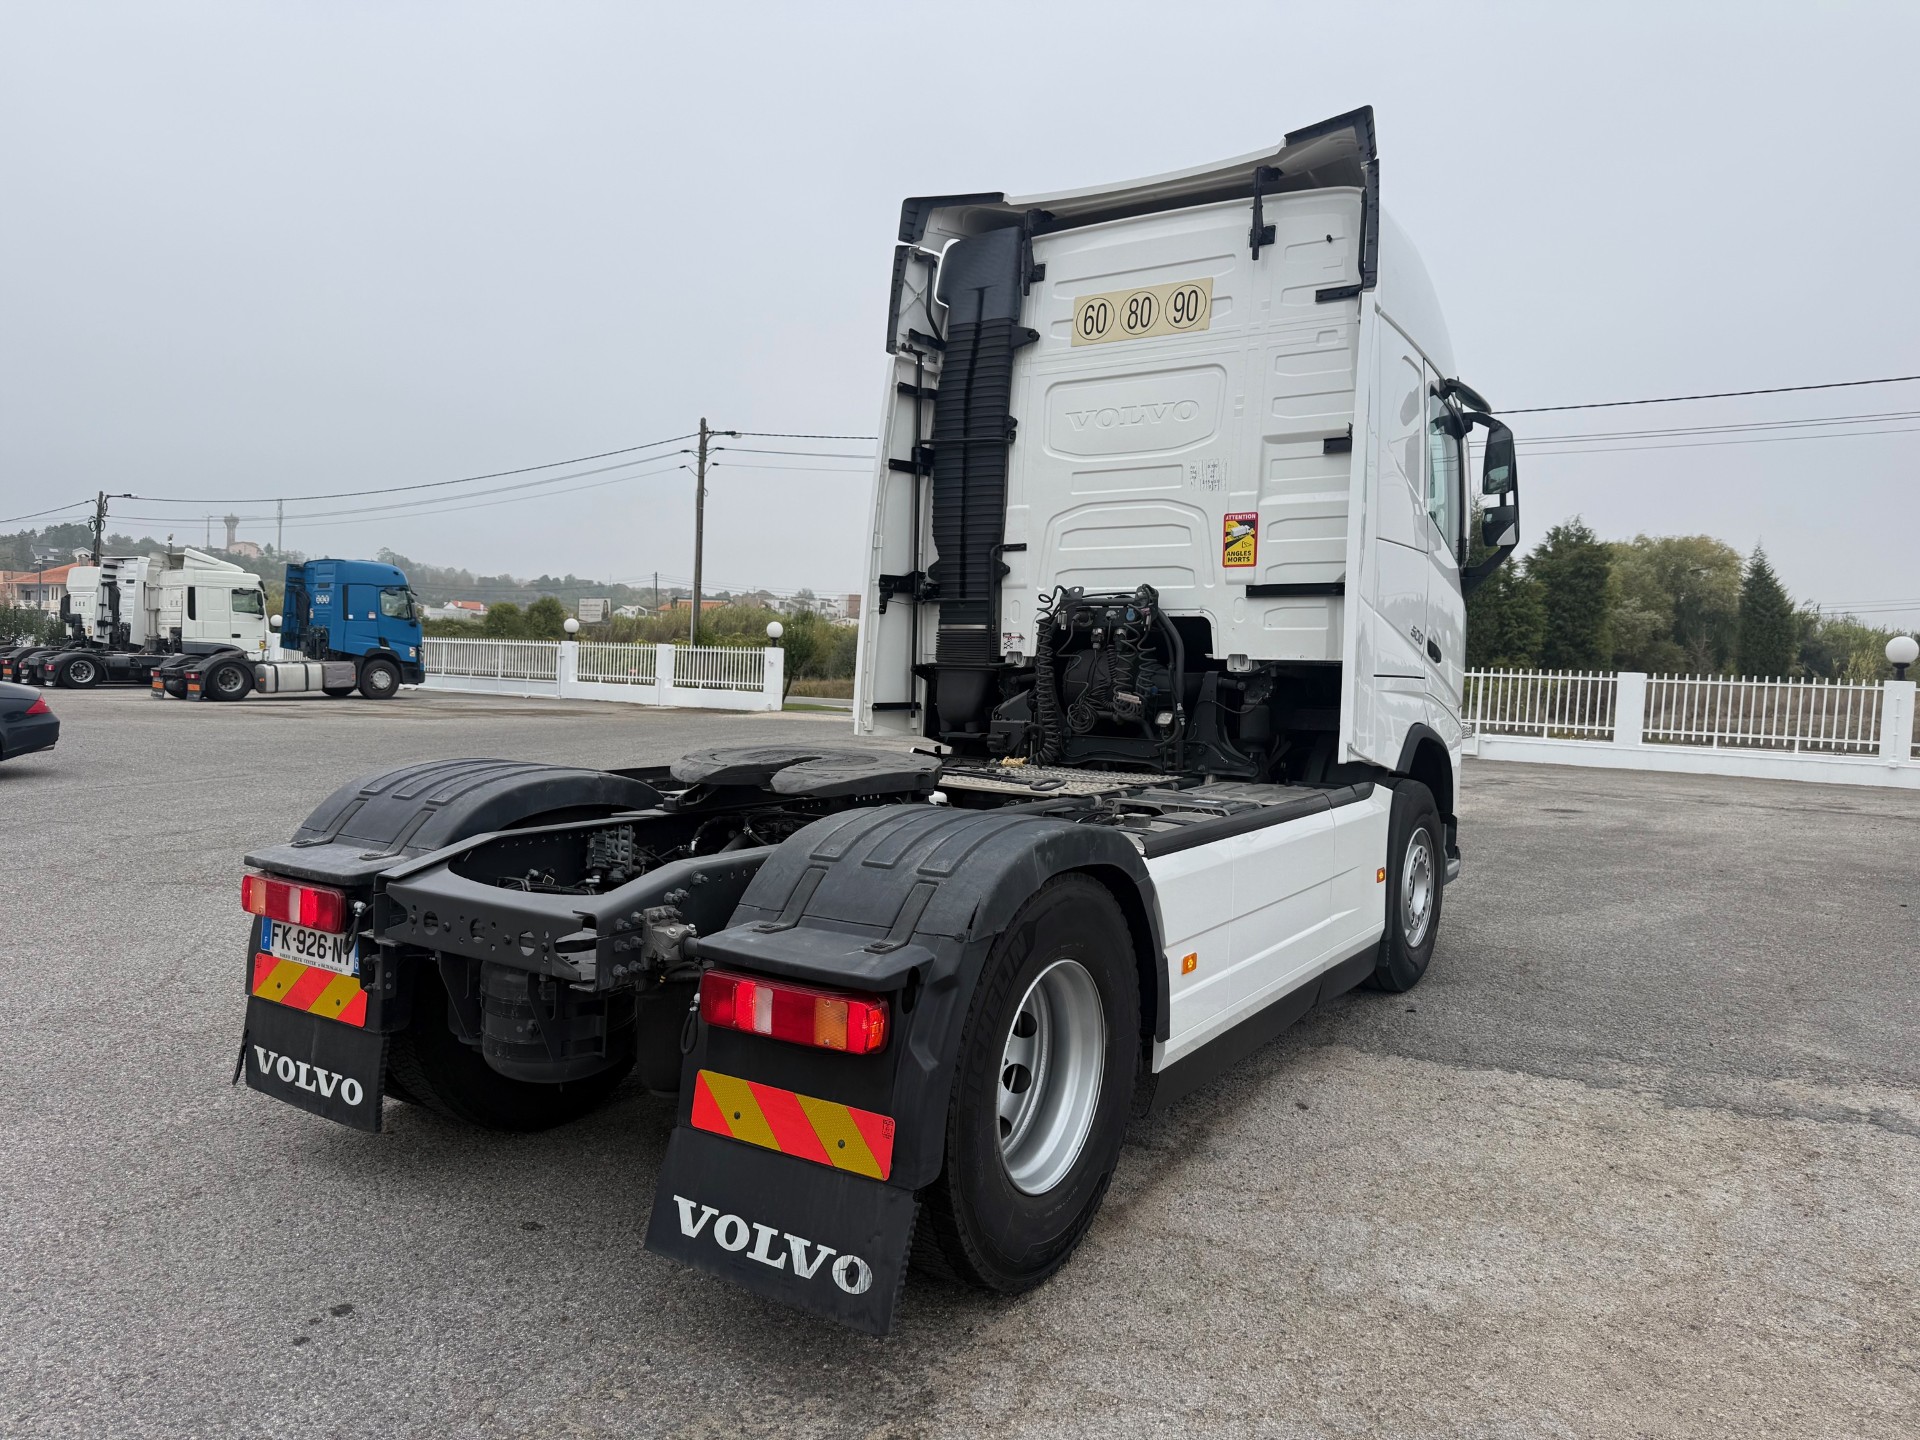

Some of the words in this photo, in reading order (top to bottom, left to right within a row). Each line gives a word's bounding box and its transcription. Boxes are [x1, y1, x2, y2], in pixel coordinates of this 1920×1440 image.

[1083, 303, 1107, 335] 60
[1127, 296, 1152, 329] 80
[1173, 289, 1198, 323] 90
[1065, 400, 1199, 431] VOLVO
[963, 930, 1028, 1132] MICHELIN
[254, 1044, 363, 1106] VOLVO
[673, 1195, 873, 1294] VOLVO
